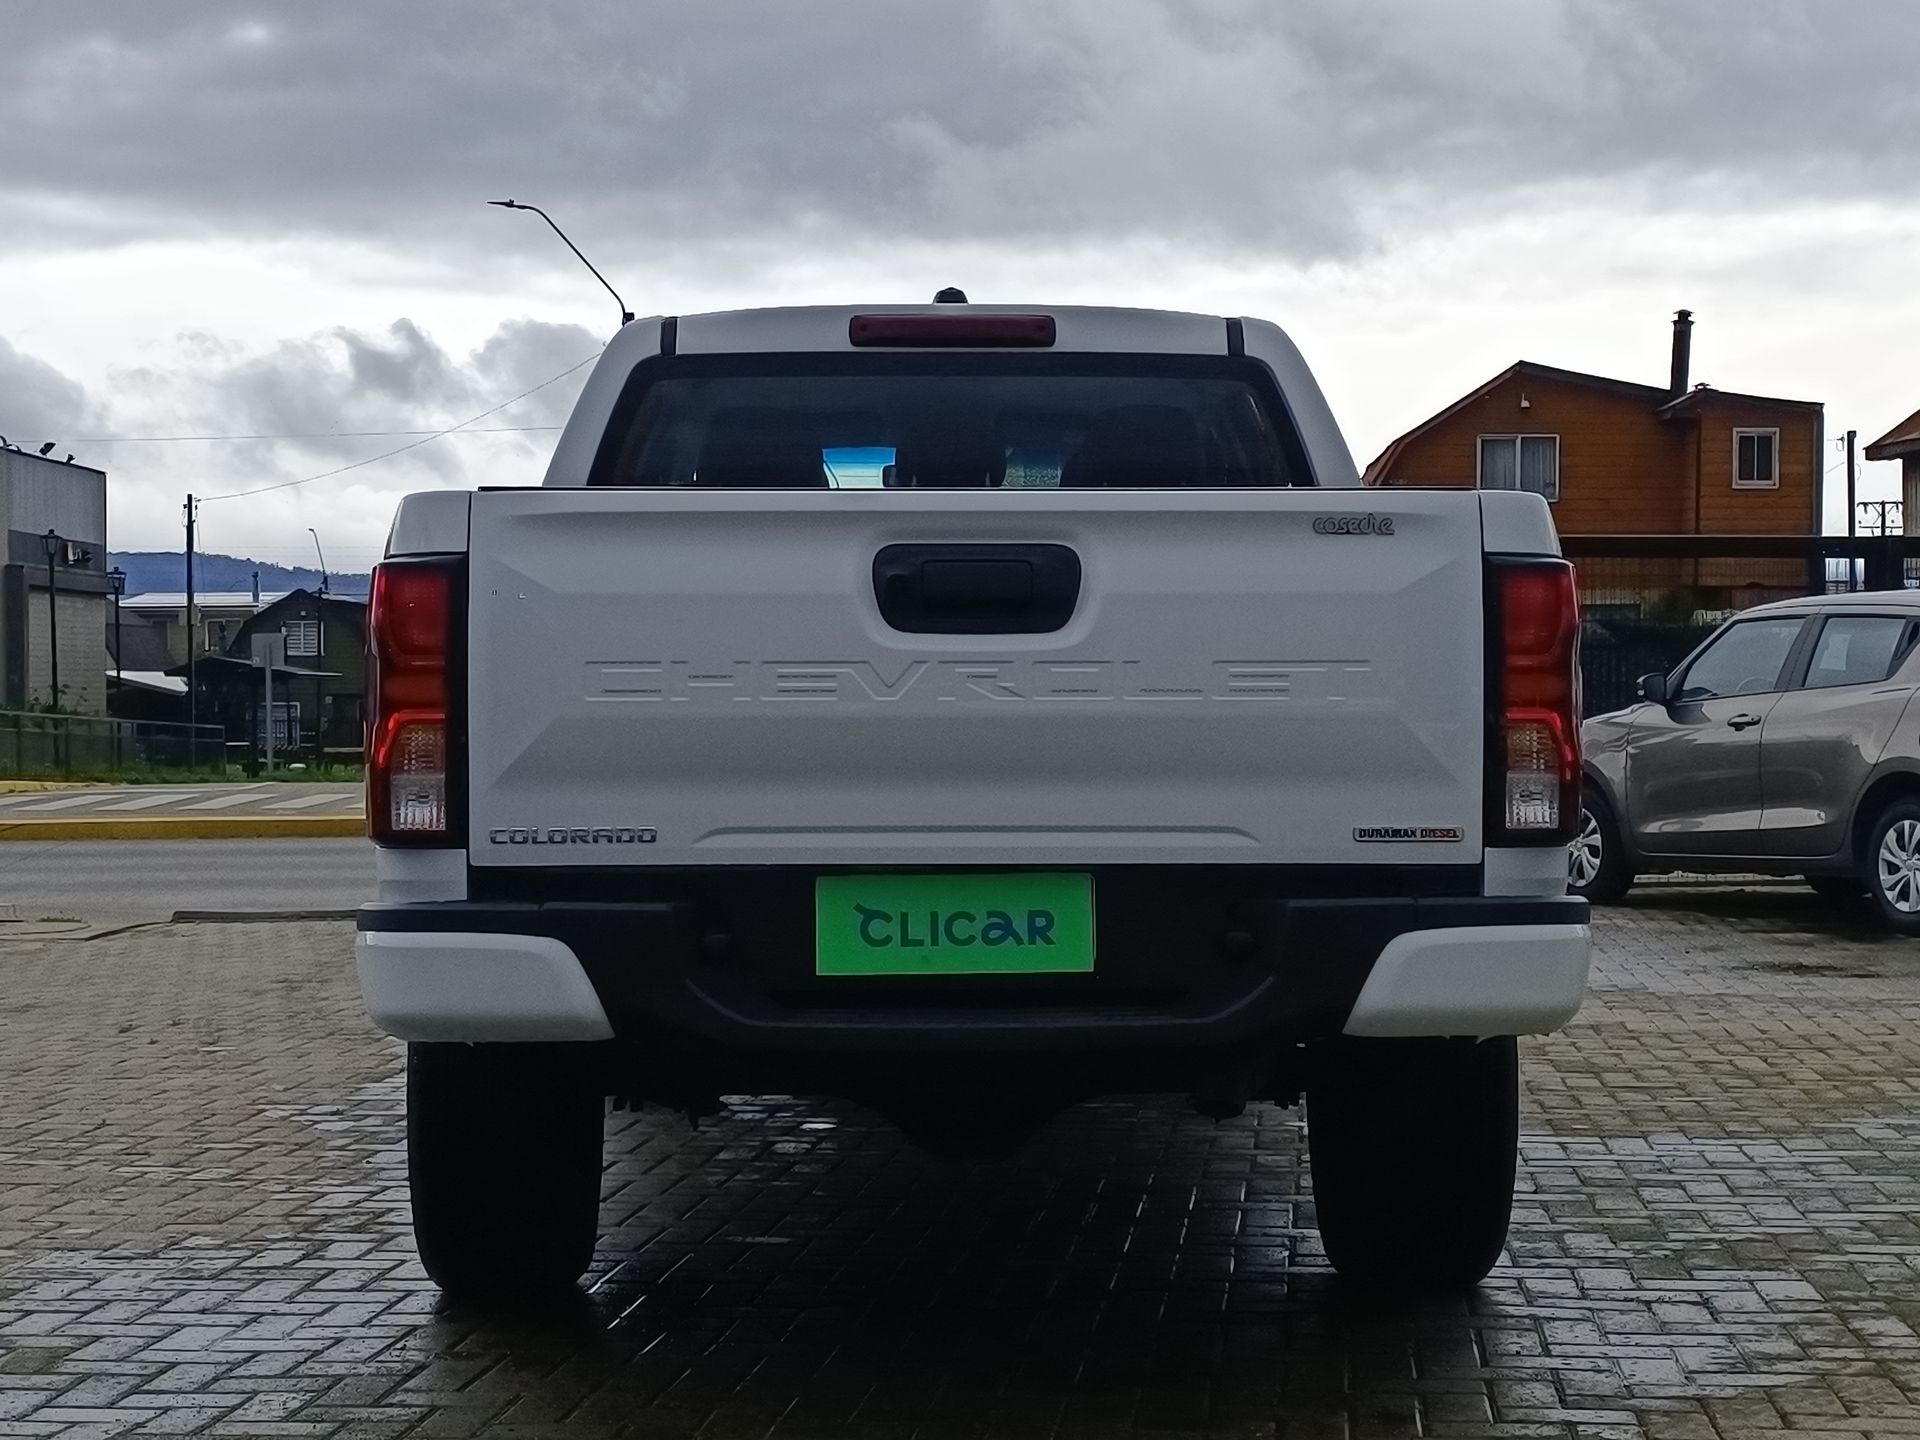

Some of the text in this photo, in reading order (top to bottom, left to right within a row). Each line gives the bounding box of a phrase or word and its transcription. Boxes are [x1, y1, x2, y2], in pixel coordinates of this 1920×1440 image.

[585, 660, 1371, 700] CHEVROLET
[489, 826, 658, 845] COLORADO
[1359, 828, 1459, 838] DURAMAX DIESEL
